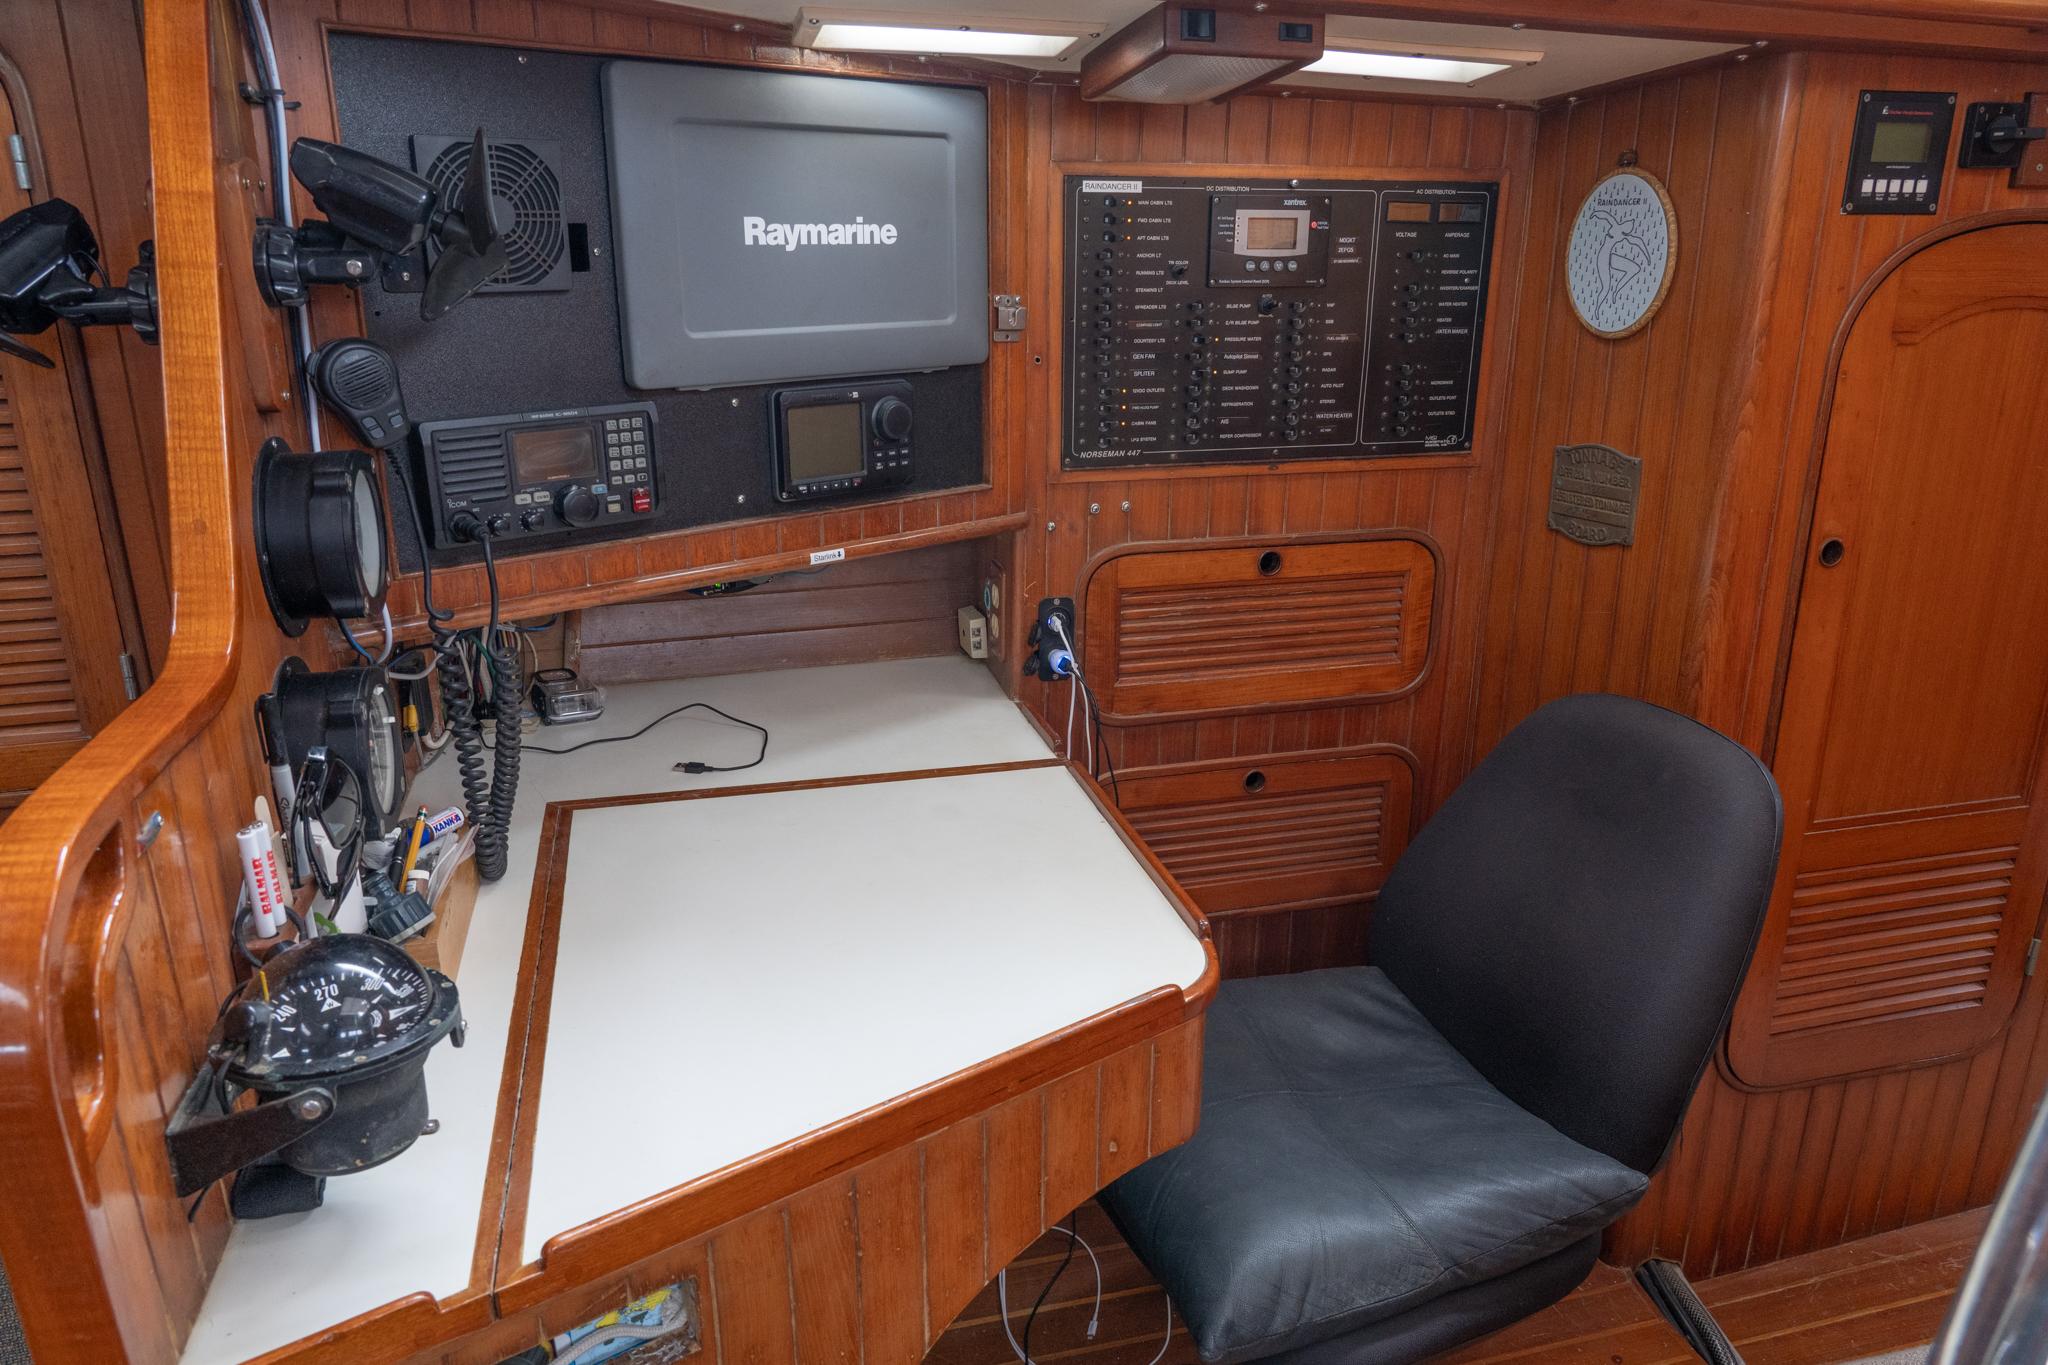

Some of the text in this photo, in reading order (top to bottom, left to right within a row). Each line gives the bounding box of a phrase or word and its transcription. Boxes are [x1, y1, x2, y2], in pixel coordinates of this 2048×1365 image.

[1085, 182, 1132, 190] RAINDANCER
[1597, 197, 1641, 206] RAINDANCER
[743, 216, 898, 251] Raymarine
[1080, 449, 1142, 459] NORSEMAN 447
[251, 857, 272, 914] BALMAR
[266, 850, 284, 905] BALMAR
[314, 984, 339, 1001] 270
[360, 977, 385, 991] 300
[273, 1004, 297, 1023] 240
